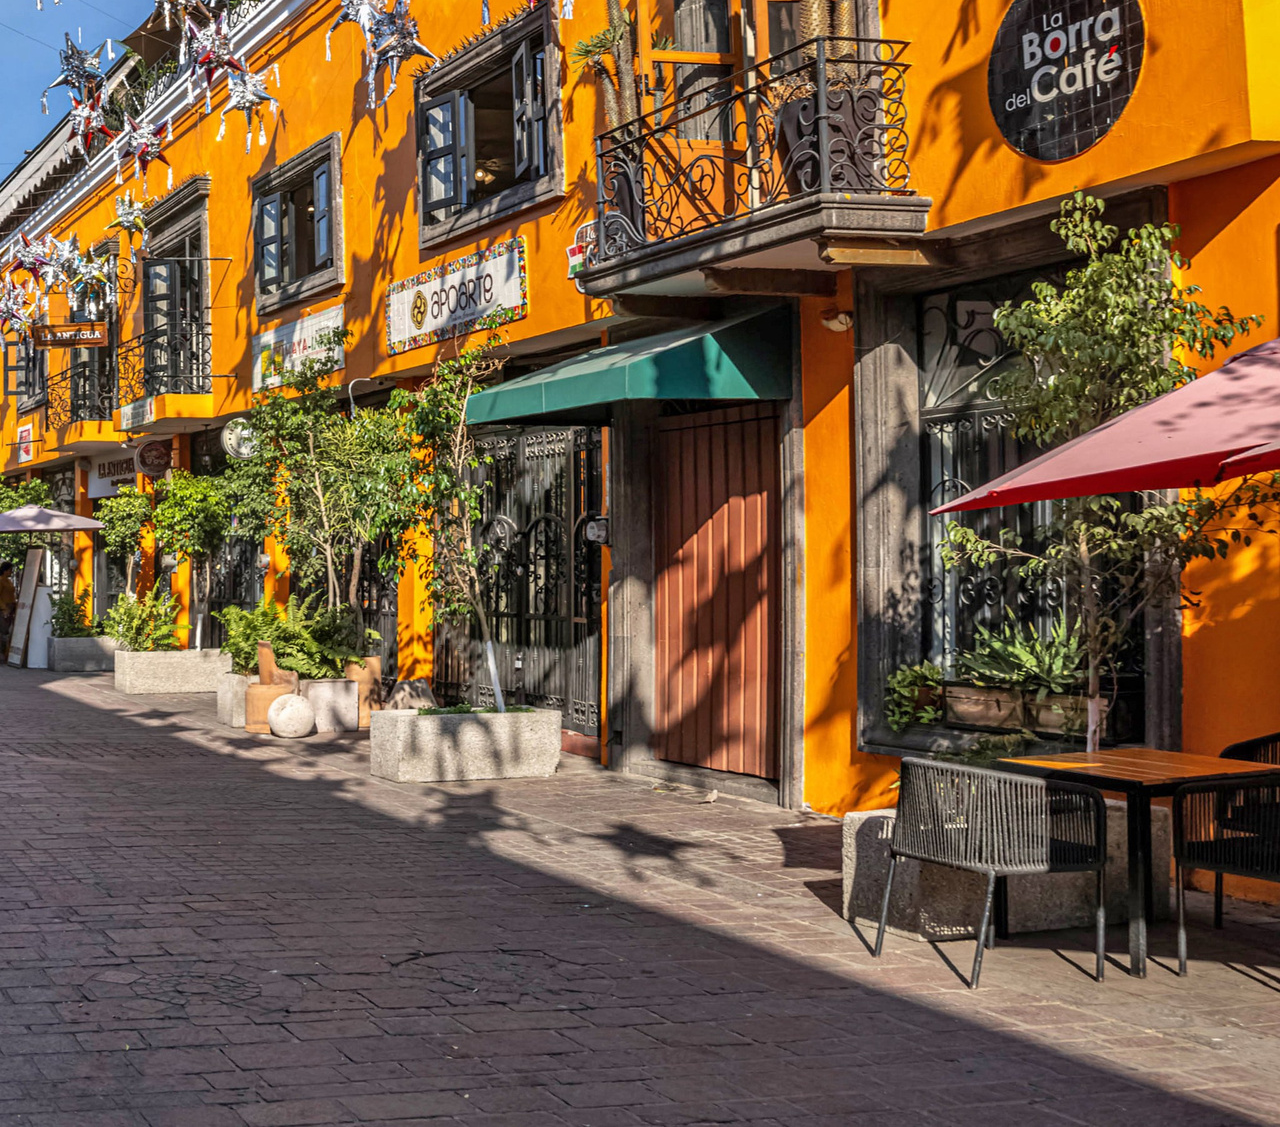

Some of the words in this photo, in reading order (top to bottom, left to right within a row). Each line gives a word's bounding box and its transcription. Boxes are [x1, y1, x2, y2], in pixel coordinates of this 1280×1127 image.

[1022, 7, 1121, 70] Borra
[1042, 12, 1063, 31] La
[1005, 89, 1031, 111] del
[1031, 45, 1123, 102] Café
[41, 333, 54, 341] LA
[55, 330, 101, 340] ANTIGUA
